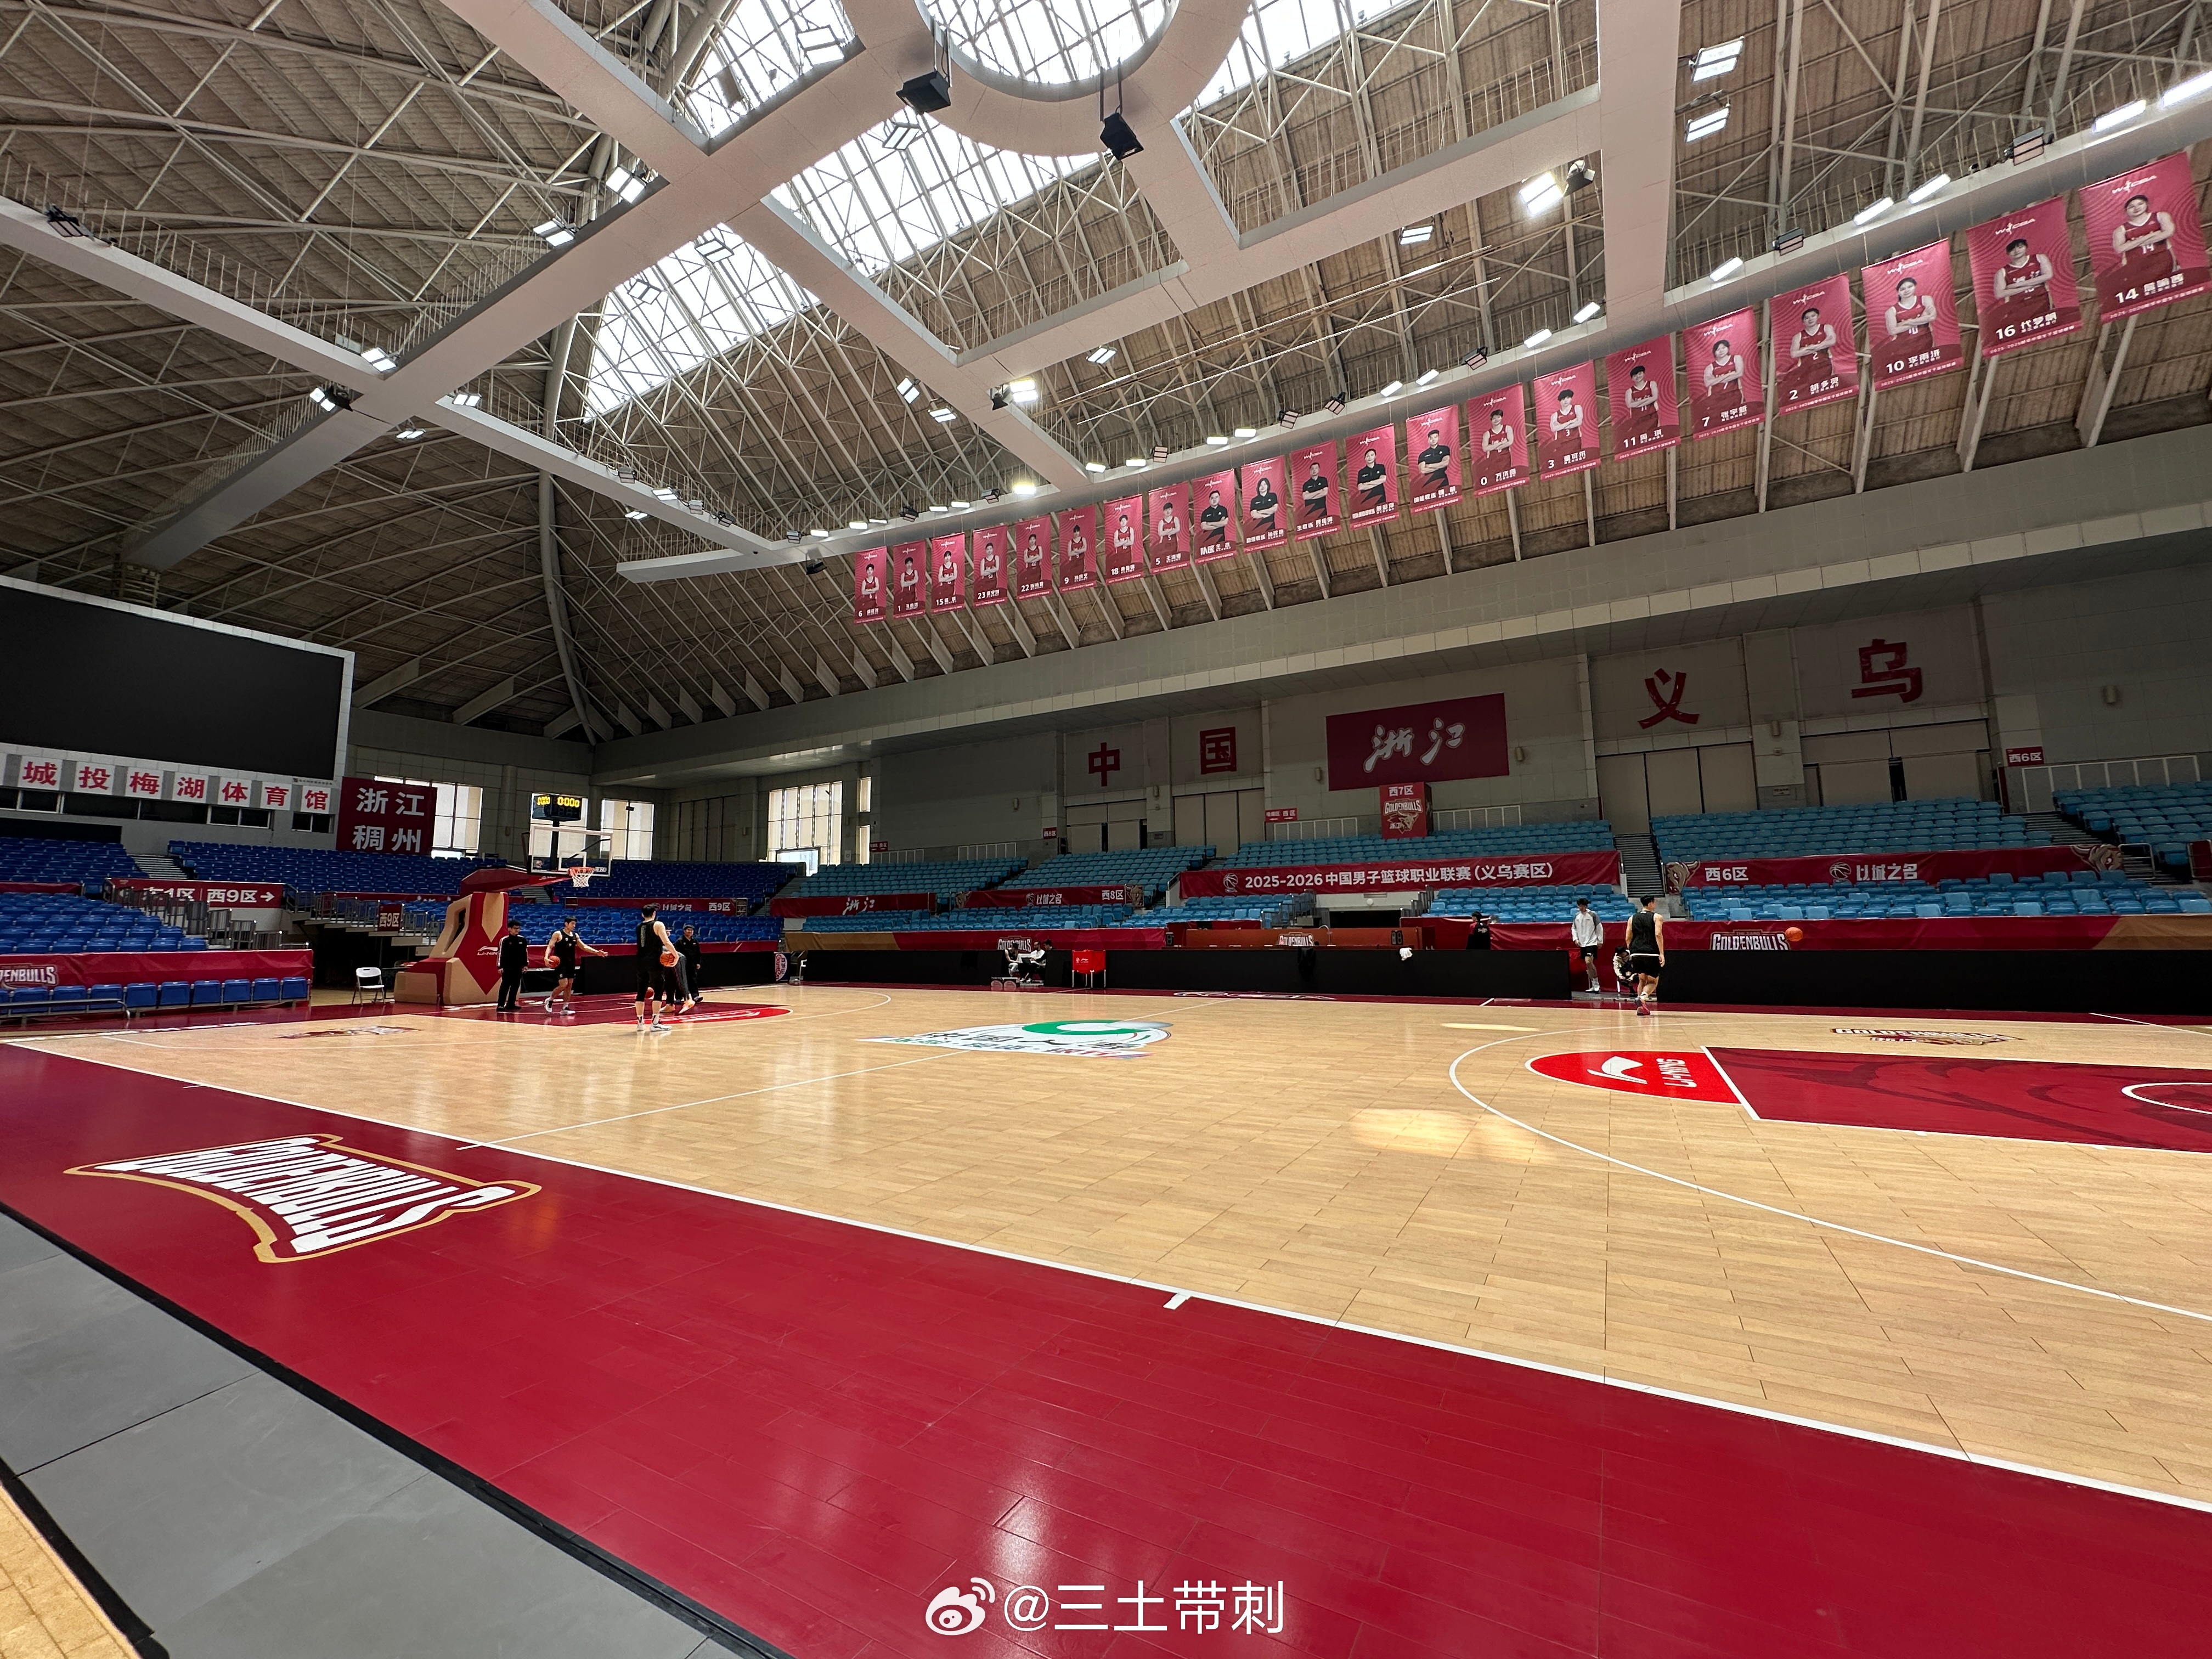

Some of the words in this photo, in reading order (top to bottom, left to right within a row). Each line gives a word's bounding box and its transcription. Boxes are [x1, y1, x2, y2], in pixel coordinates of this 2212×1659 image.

[2115, 288, 2138, 303] 14
[1996, 325, 2016, 340] 16
[1886, 360, 1905, 374] 10
[1789, 390, 1798, 400] 2
[1702, 416, 1710, 427] 7
[1623, 437, 1636, 448] 11
[1548, 459, 1555, 469] 3
[1480, 477, 1488, 486] 0
[1363, 717, 1465, 772] 浙江
[2008, 752, 2042, 763] 西6区
[22, 761, 329, 810] 城投梅湖体育馆
[1389, 785, 1414, 797] 西7区
[356, 787, 425, 816] 浙江
[1385, 800, 1422, 814] GOLDENBULLS
[352, 825, 421, 853] 稠州
[1705, 867, 1748, 881] 西6区
[1856, 864, 1918, 881] 以城之名
[207, 889, 257, 902] 西9区
[1102, 890, 1124, 900] 西8区
[708, 902, 731, 911] 西9区
[379, 913, 400, 927] 西9区
[1712, 934, 1788, 950] GOLDENBULLS
[1656, 1058, 1697, 1088] LI-NING
[94, 1137, 516, 1254] GOLDENBULLS
